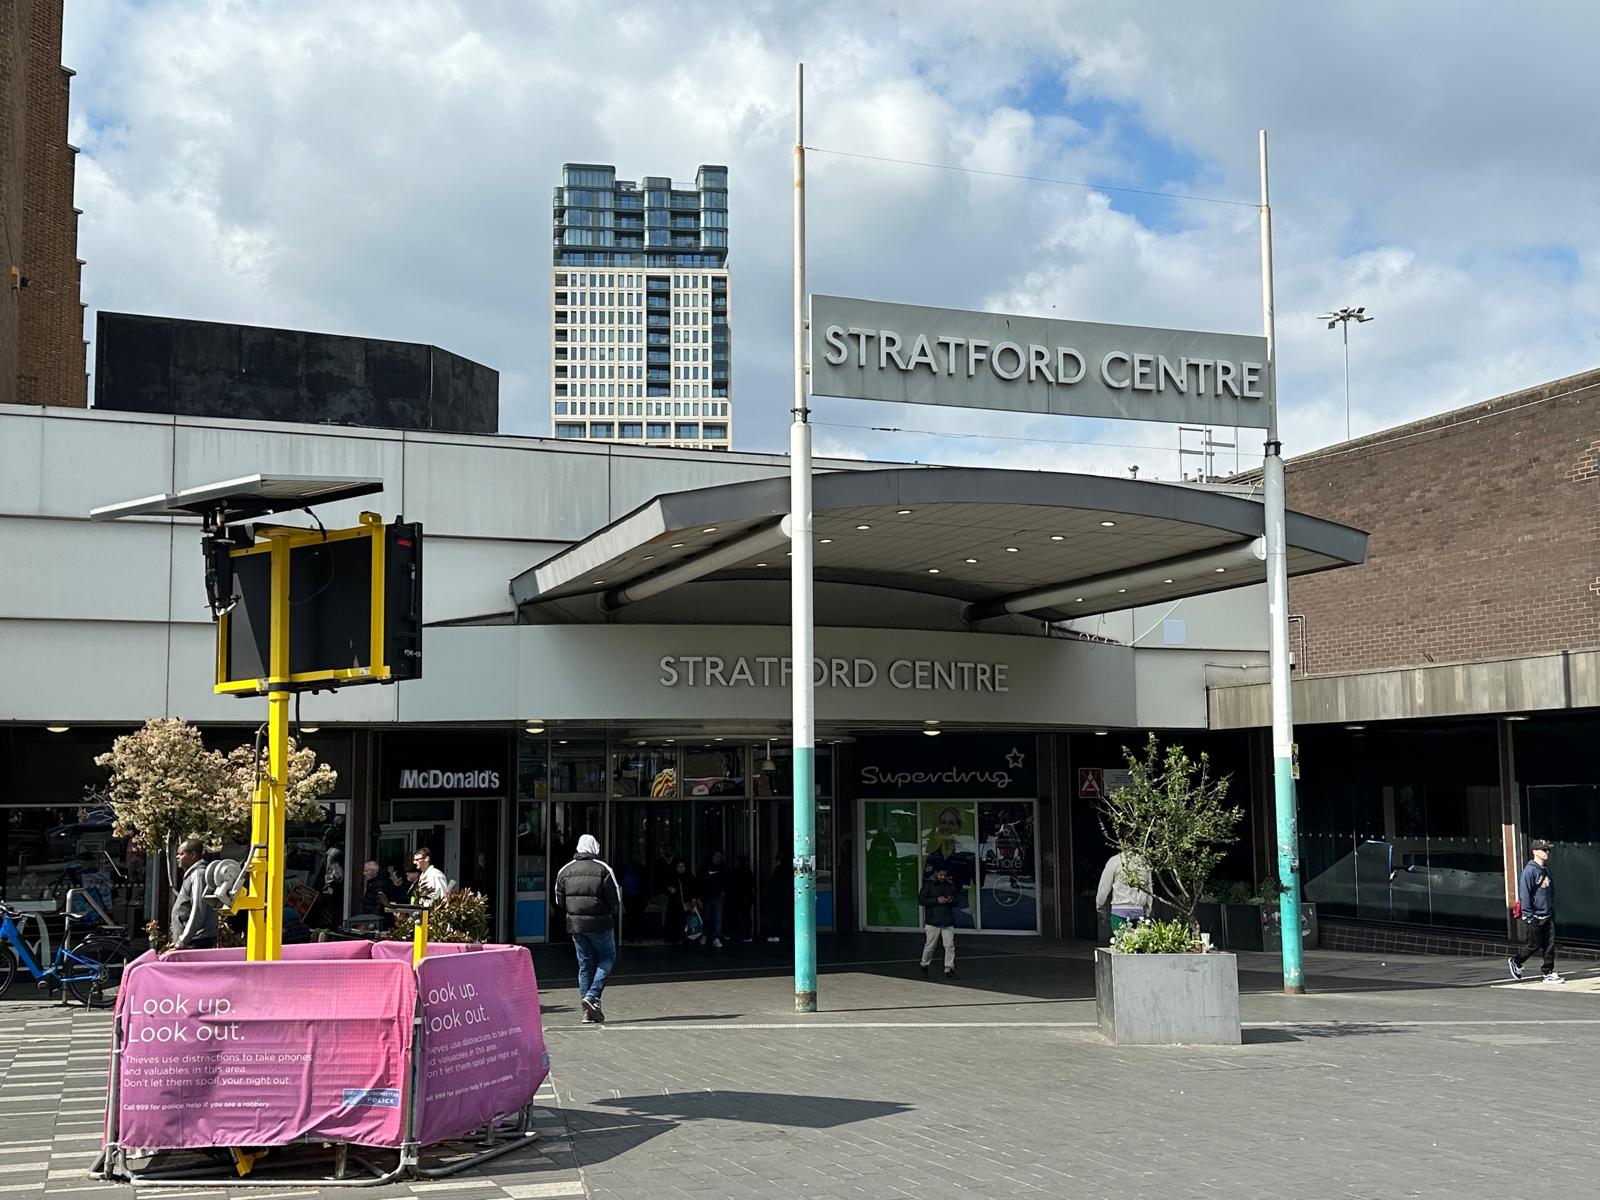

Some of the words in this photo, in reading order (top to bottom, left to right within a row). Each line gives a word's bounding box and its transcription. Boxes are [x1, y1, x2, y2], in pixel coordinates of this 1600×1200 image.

[824, 325, 1086, 385] STRATFORD
[1100, 350, 1264, 399] CENTRE
[888, 660, 1009, 692] CENTRE
[399, 769, 500, 789] McDonald's
[861, 766, 1012, 788] Superdrug
[459, 983, 478, 1001] up.
[130, 993, 190, 1015] Look
[198, 998, 236, 1017] up.
[465, 1004, 490, 1024] out.
[128, 1021, 188, 1043] Look
[196, 1022, 245, 1041] out.
[126, 1055, 160, 1064] Thieves
[162, 1056, 180, 1064] use
[182, 1054, 240, 1063] distractions
[242, 1054, 253, 1062] to
[255, 1053, 276, 1062] take
[278, 1054, 312, 1063] phones
[124, 1067, 141, 1076] and
[143, 1066, 189, 1075] valuables
[192, 1065, 201, 1074] in
[204, 1065, 223, 1074] this
[124, 1078, 149, 1088] Don't
[150, 1078, 162, 1087] let
[166, 1078, 193, 1087] them
[194, 1076, 219, 1086] spoil
[221, 1077, 244, 1086] your
[245, 1076, 271, 1086] night
[123, 1103, 135, 1111] Call
[161, 1102, 184, 1111] police
[242, 1101, 270, 1109] robbery.
